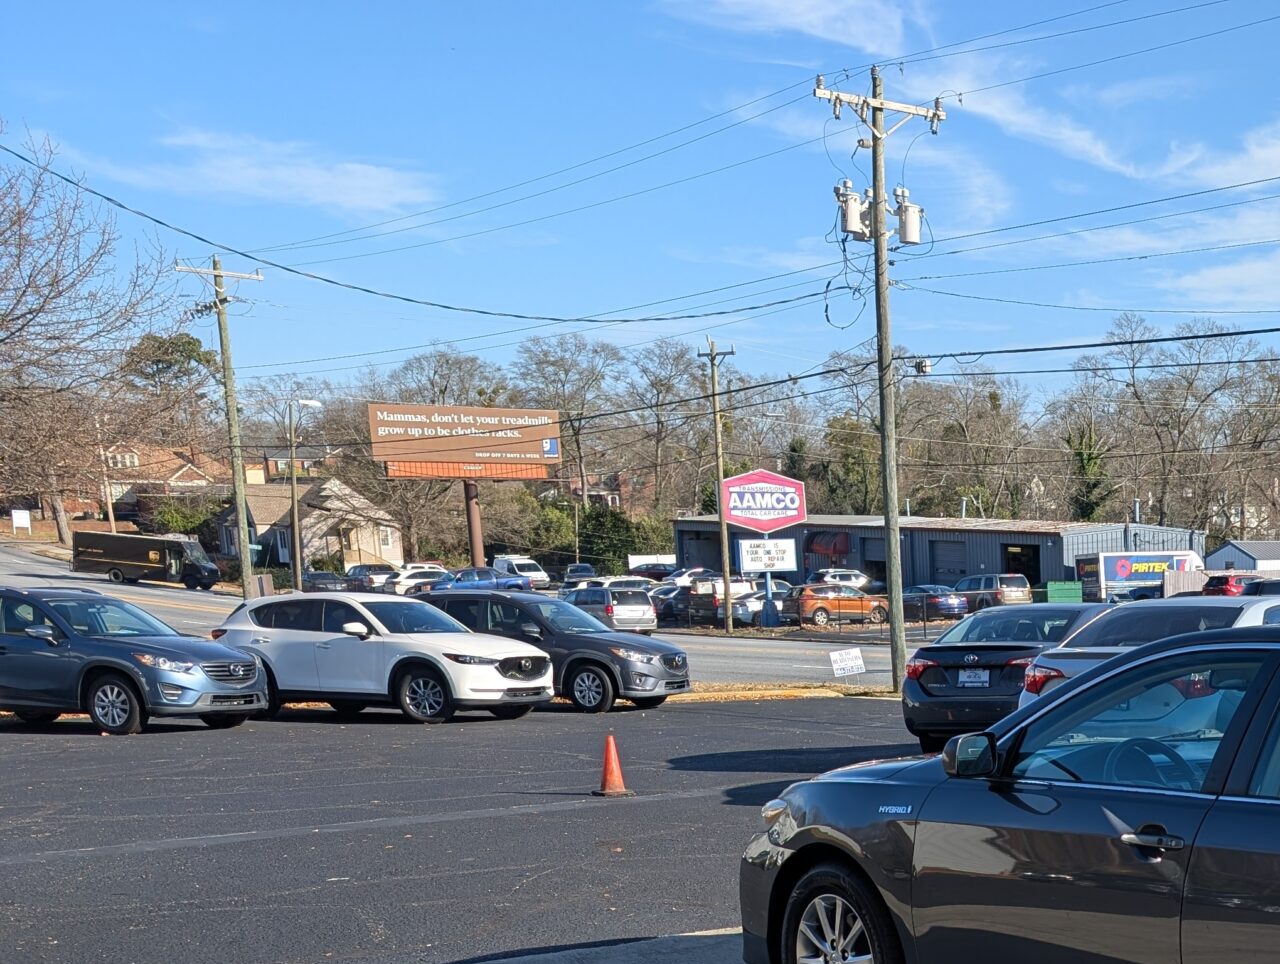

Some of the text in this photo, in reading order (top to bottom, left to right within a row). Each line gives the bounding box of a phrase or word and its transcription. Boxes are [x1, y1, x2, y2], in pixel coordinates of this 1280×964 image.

[376, 411, 429, 423] Mammas,
[432, 413, 458, 423] don't
[461, 414, 475, 424] let
[476, 416, 500, 426] your
[378, 427, 405, 436] grow
[407, 427, 422, 437] up
[424, 427, 435, 436] to
[437, 426, 451, 436] be
[729, 492, 800, 509] AAMCO
[1131, 562, 1169, 573] PIRTEK
[878, 805, 907, 814] HYBRID
